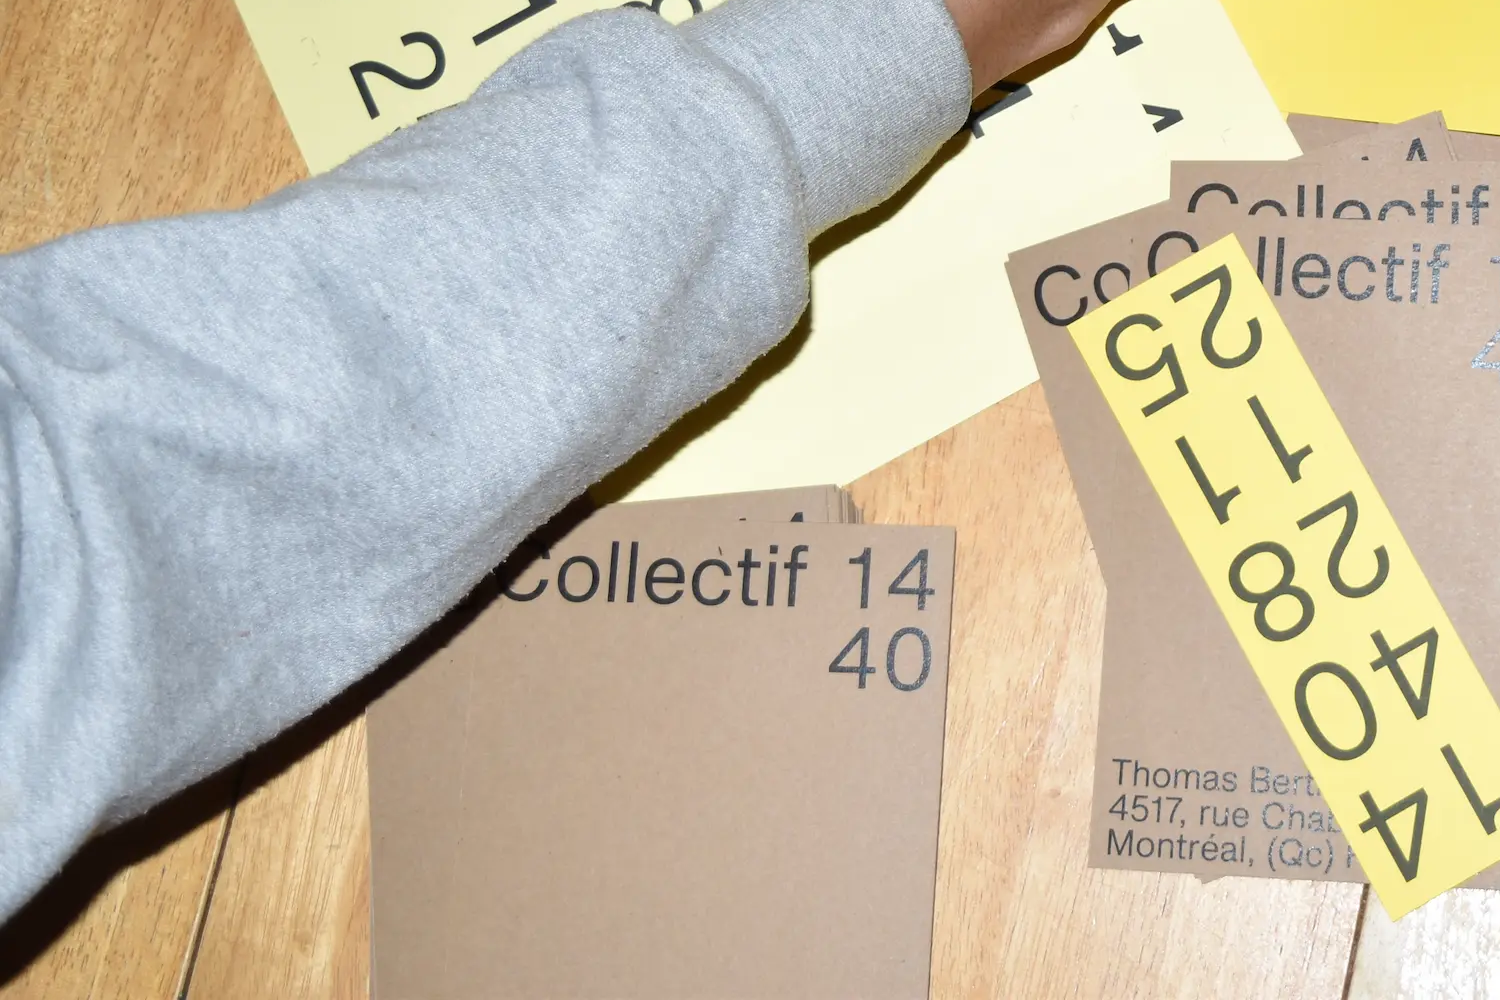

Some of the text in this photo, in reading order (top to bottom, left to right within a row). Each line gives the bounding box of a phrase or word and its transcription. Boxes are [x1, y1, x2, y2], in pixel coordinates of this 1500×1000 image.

[1104, 264, 1263, 418] 25
[1174, 395, 1316, 525] 11
[849, 548, 935, 612] 14
[1227, 490, 1391, 643] 28
[829, 625, 933, 692] 40
[1293, 626, 1440, 762] 40
[1108, 794, 1186, 828] 4517,
[1199, 804, 1250, 828] rue
[1112, 758, 1322, 797] Thomas Bert
[1107, 828, 1254, 867] Montréal,
[1267, 835, 1334, 874] (Qc)
